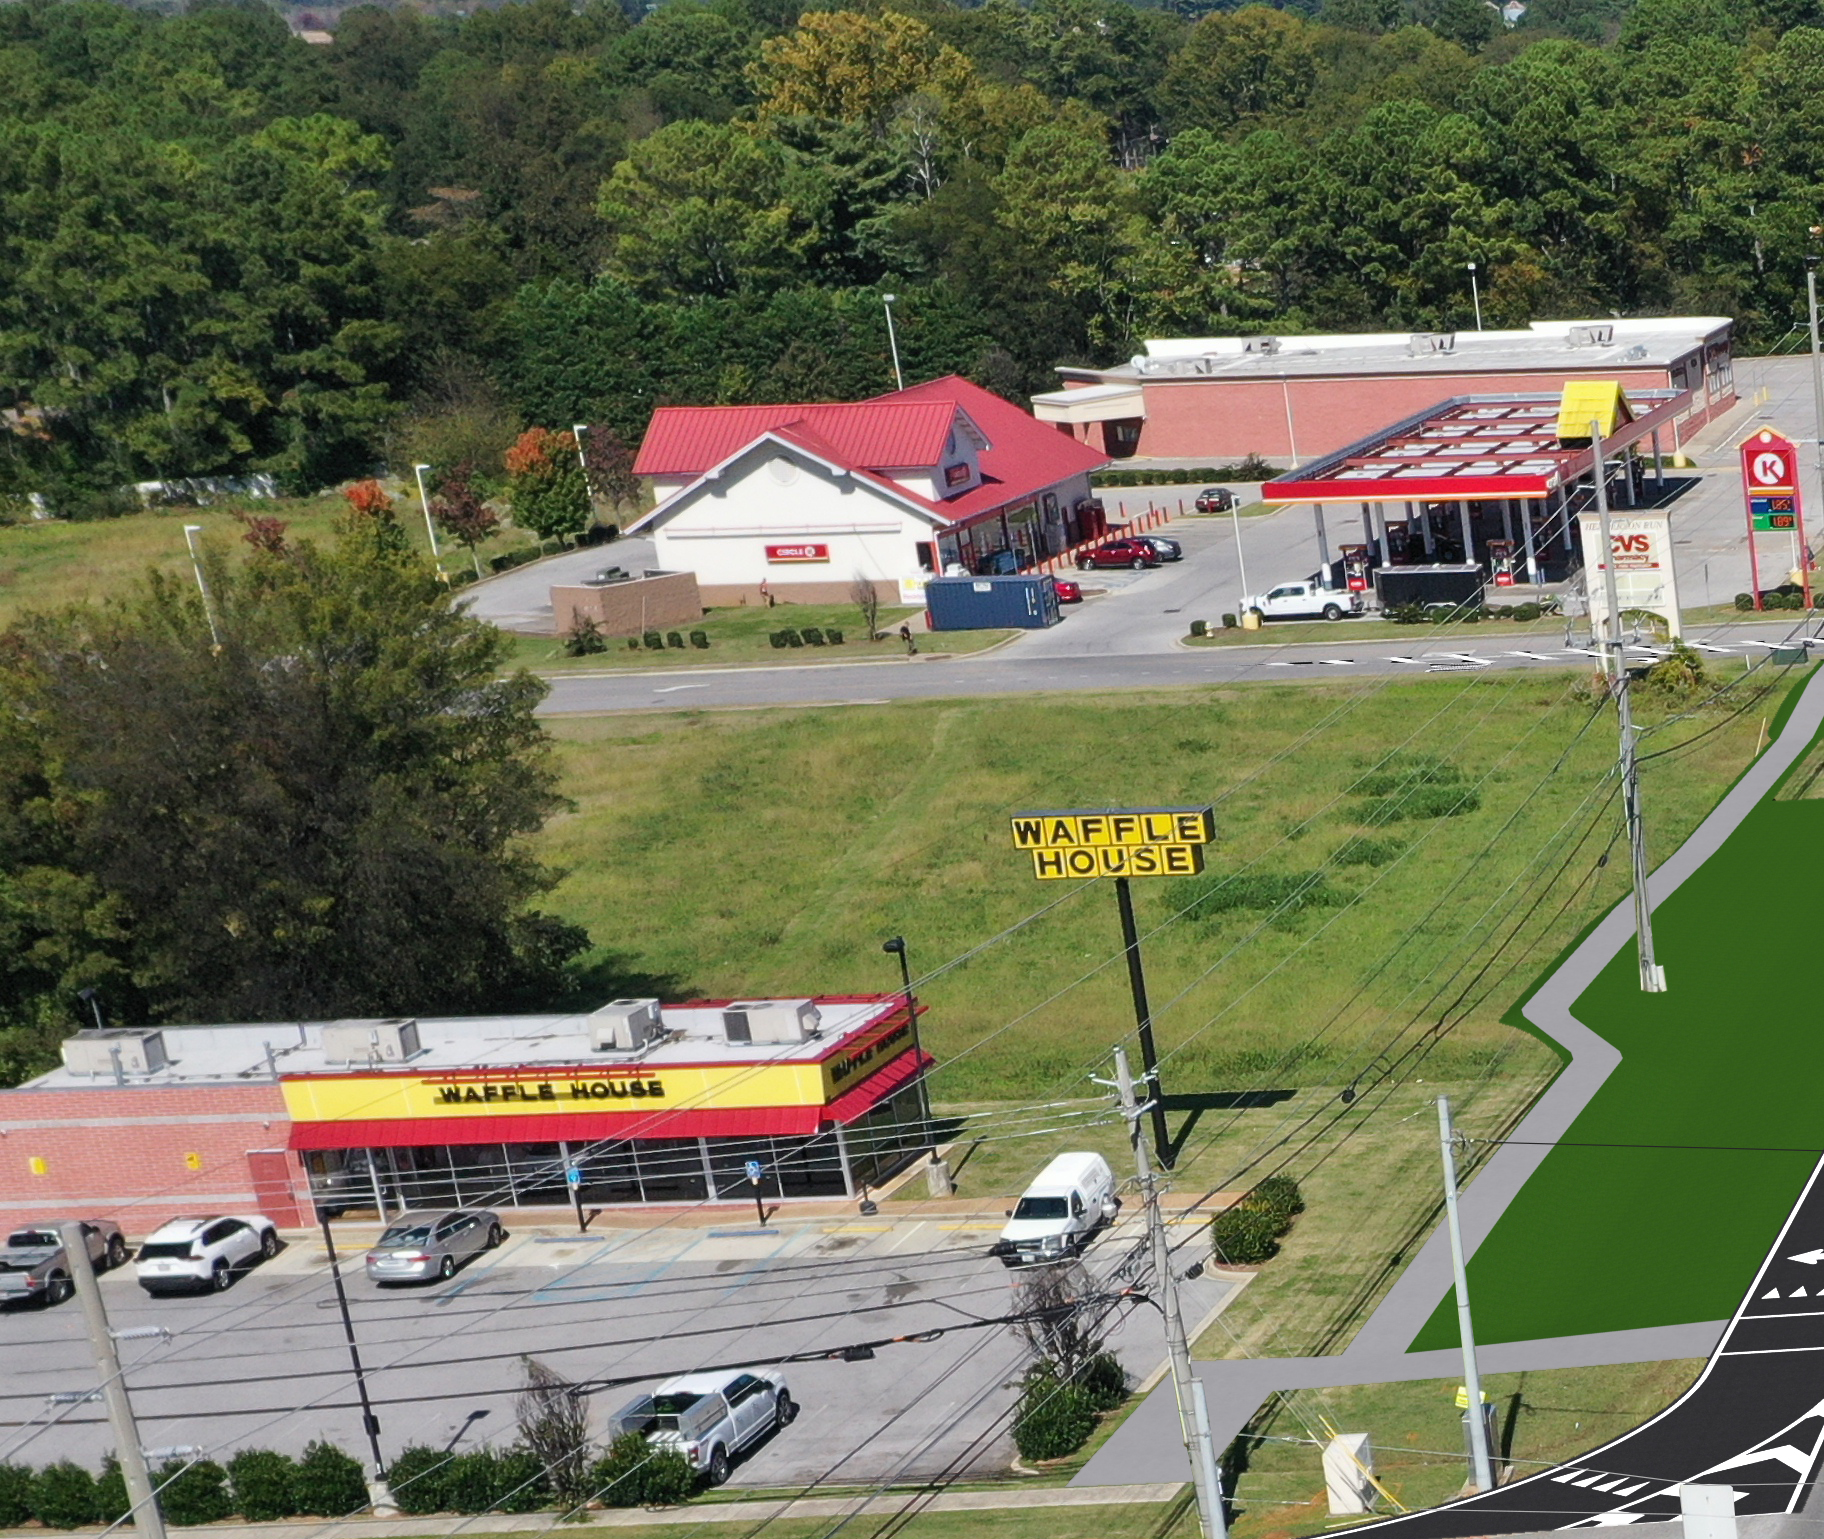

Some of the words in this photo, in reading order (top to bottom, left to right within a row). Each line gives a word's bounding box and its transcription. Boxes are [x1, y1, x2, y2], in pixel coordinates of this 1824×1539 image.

[1013, 815, 1201, 846] WAFFLE
[1036, 847, 1190, 876] HOUSE
[439, 1083, 557, 1104] WAFFLE
[570, 1080, 665, 1100] HOUSE
